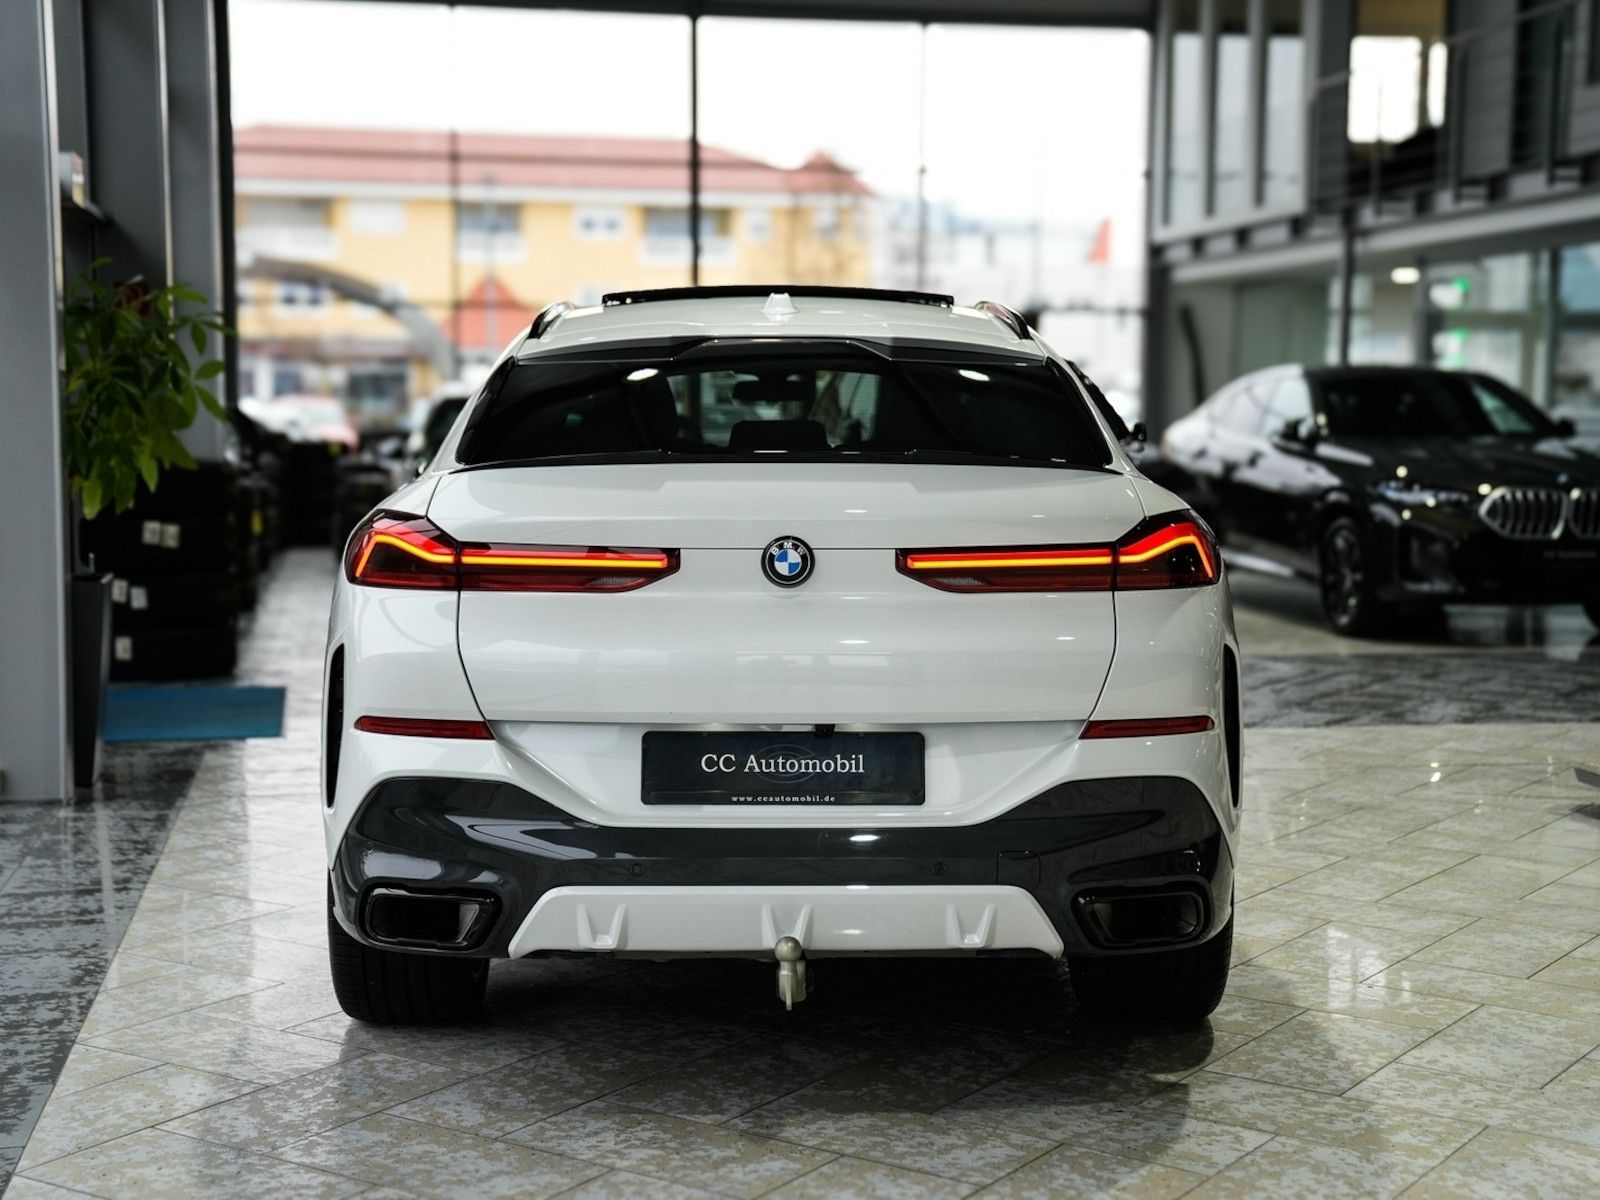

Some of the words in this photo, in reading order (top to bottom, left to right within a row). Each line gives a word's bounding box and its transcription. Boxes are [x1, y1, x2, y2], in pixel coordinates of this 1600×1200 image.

[770, 541, 806, 556] BMW
[700, 753, 736, 773] CC
[743, 753, 865, 773] Automobil
[731, 794, 836, 802] www.ccautomobil.de
